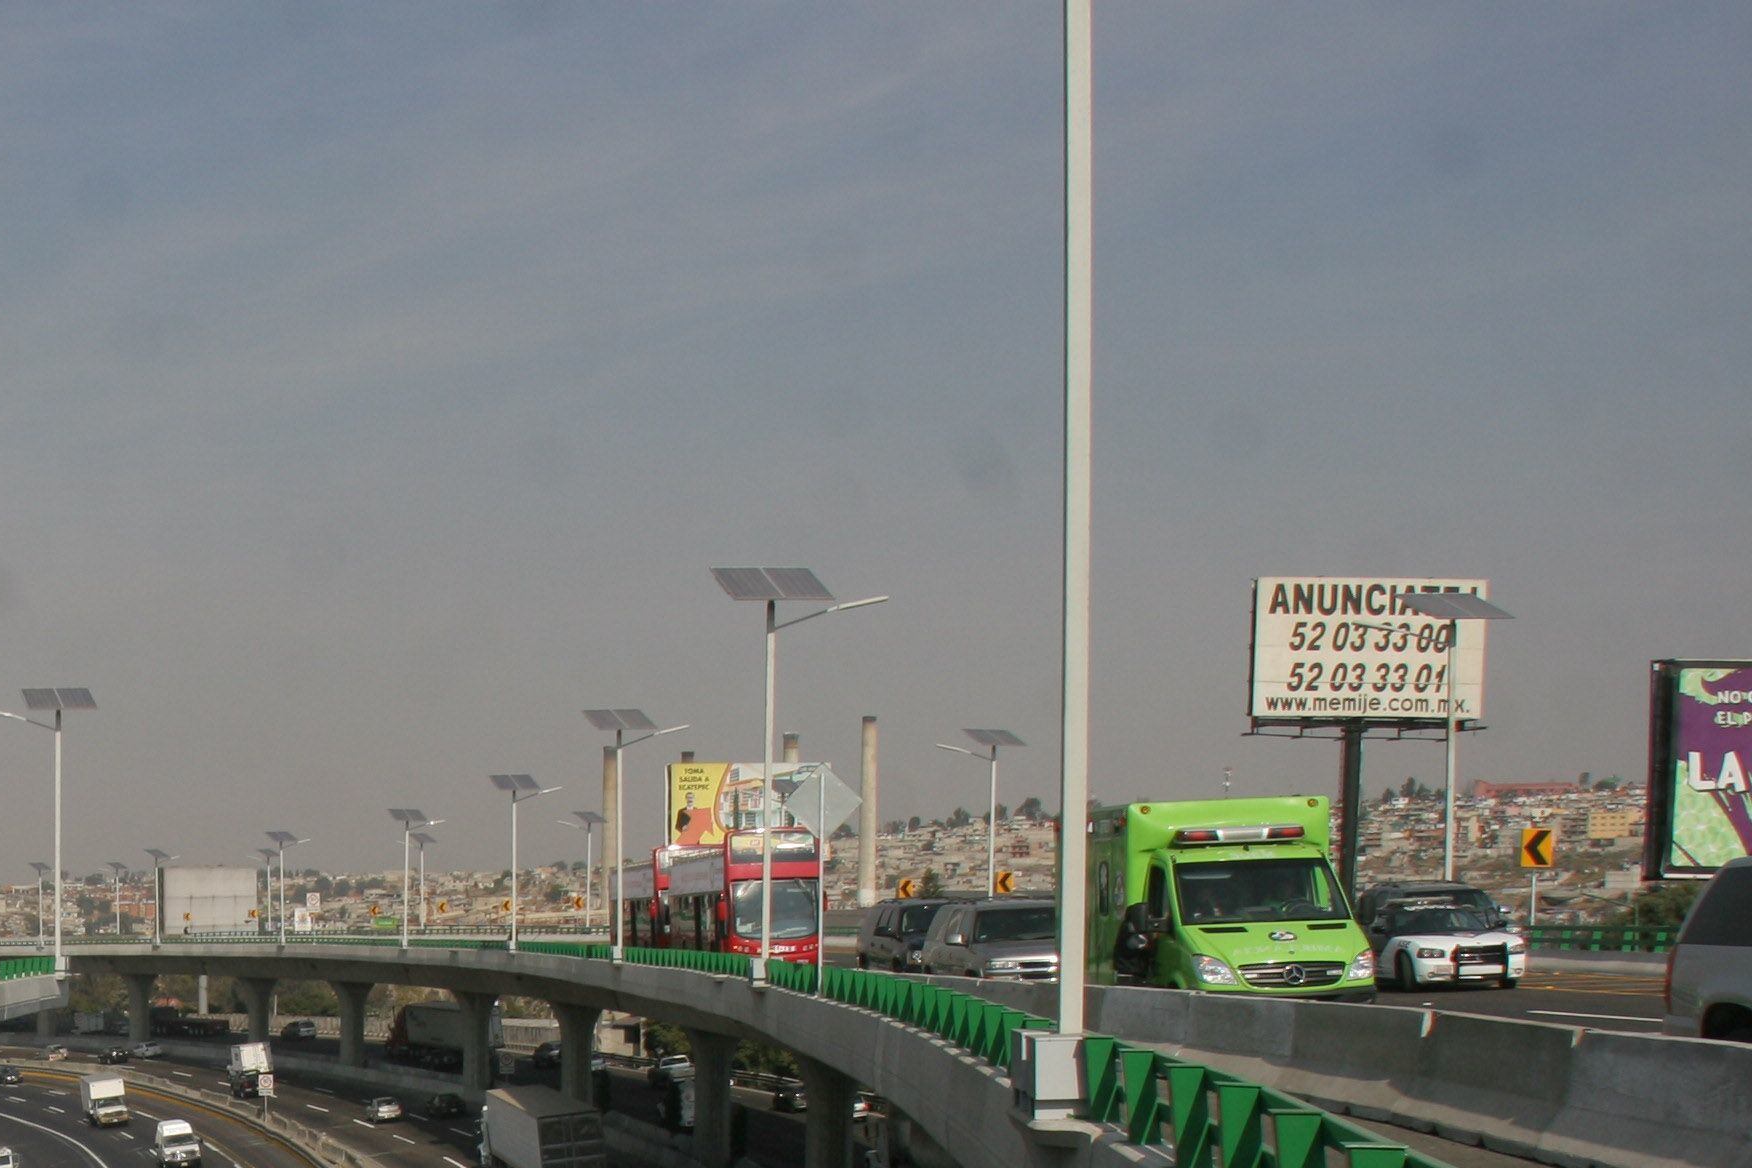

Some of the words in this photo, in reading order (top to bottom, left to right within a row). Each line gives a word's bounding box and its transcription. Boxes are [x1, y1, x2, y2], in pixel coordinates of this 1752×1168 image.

[1268, 583, 1459, 615] ANUNCIA
[1288, 621, 1326, 651] 52
[1332, 621, 1367, 652] 03
[1374, 622, 1410, 652] 33
[1416, 622, 1450, 653] 00
[1286, 662, 1323, 692] 52
[1329, 662, 1366, 692] 03
[1372, 662, 1408, 692] 33
[1414, 662, 1447, 693] 01
[1717, 690, 1741, 704] NO
[1717, 710, 1737, 725] EL
[1688, 751, 1749, 793] LA
